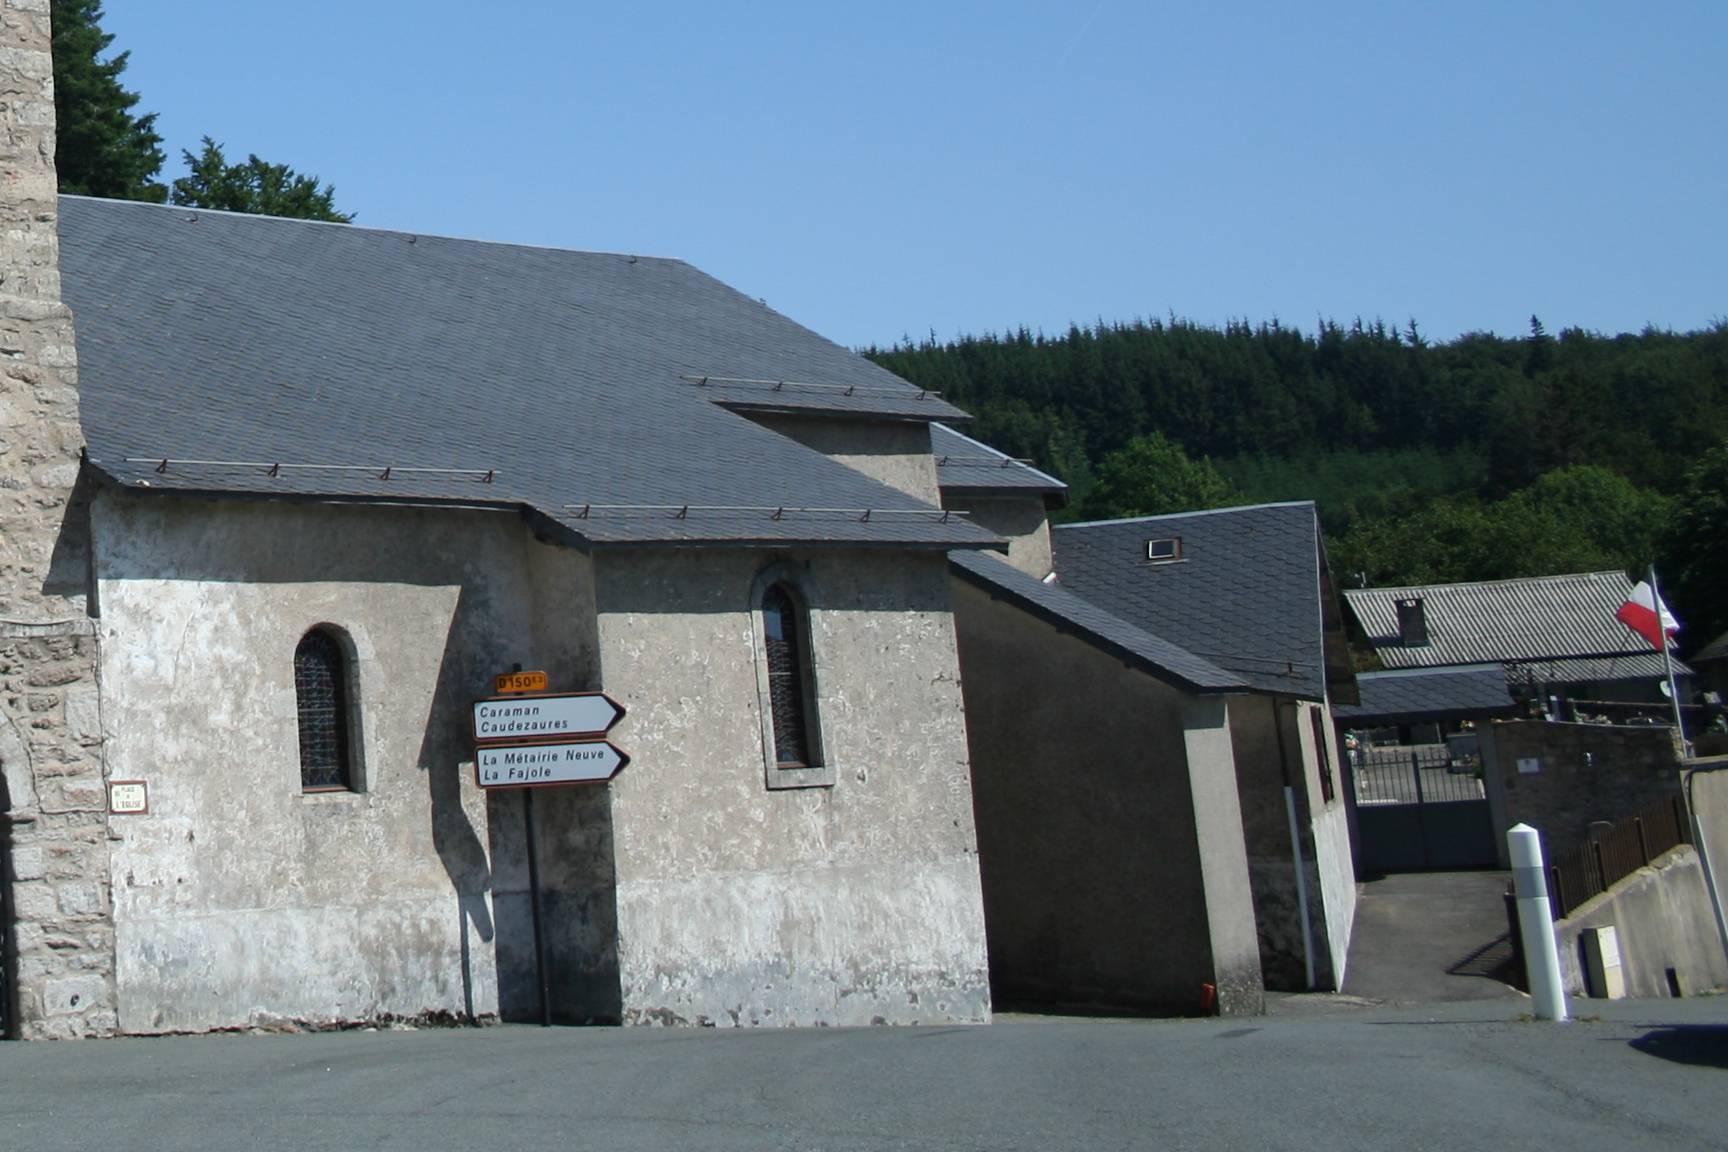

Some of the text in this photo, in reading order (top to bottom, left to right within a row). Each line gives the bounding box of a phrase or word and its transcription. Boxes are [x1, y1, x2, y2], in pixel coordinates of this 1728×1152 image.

[480, 706, 539, 718] Caraman
[481, 720, 568, 732] Caudezaures
[483, 749, 605, 766] La Métairie Neuve
[484, 766, 552, 781] La Fajole
